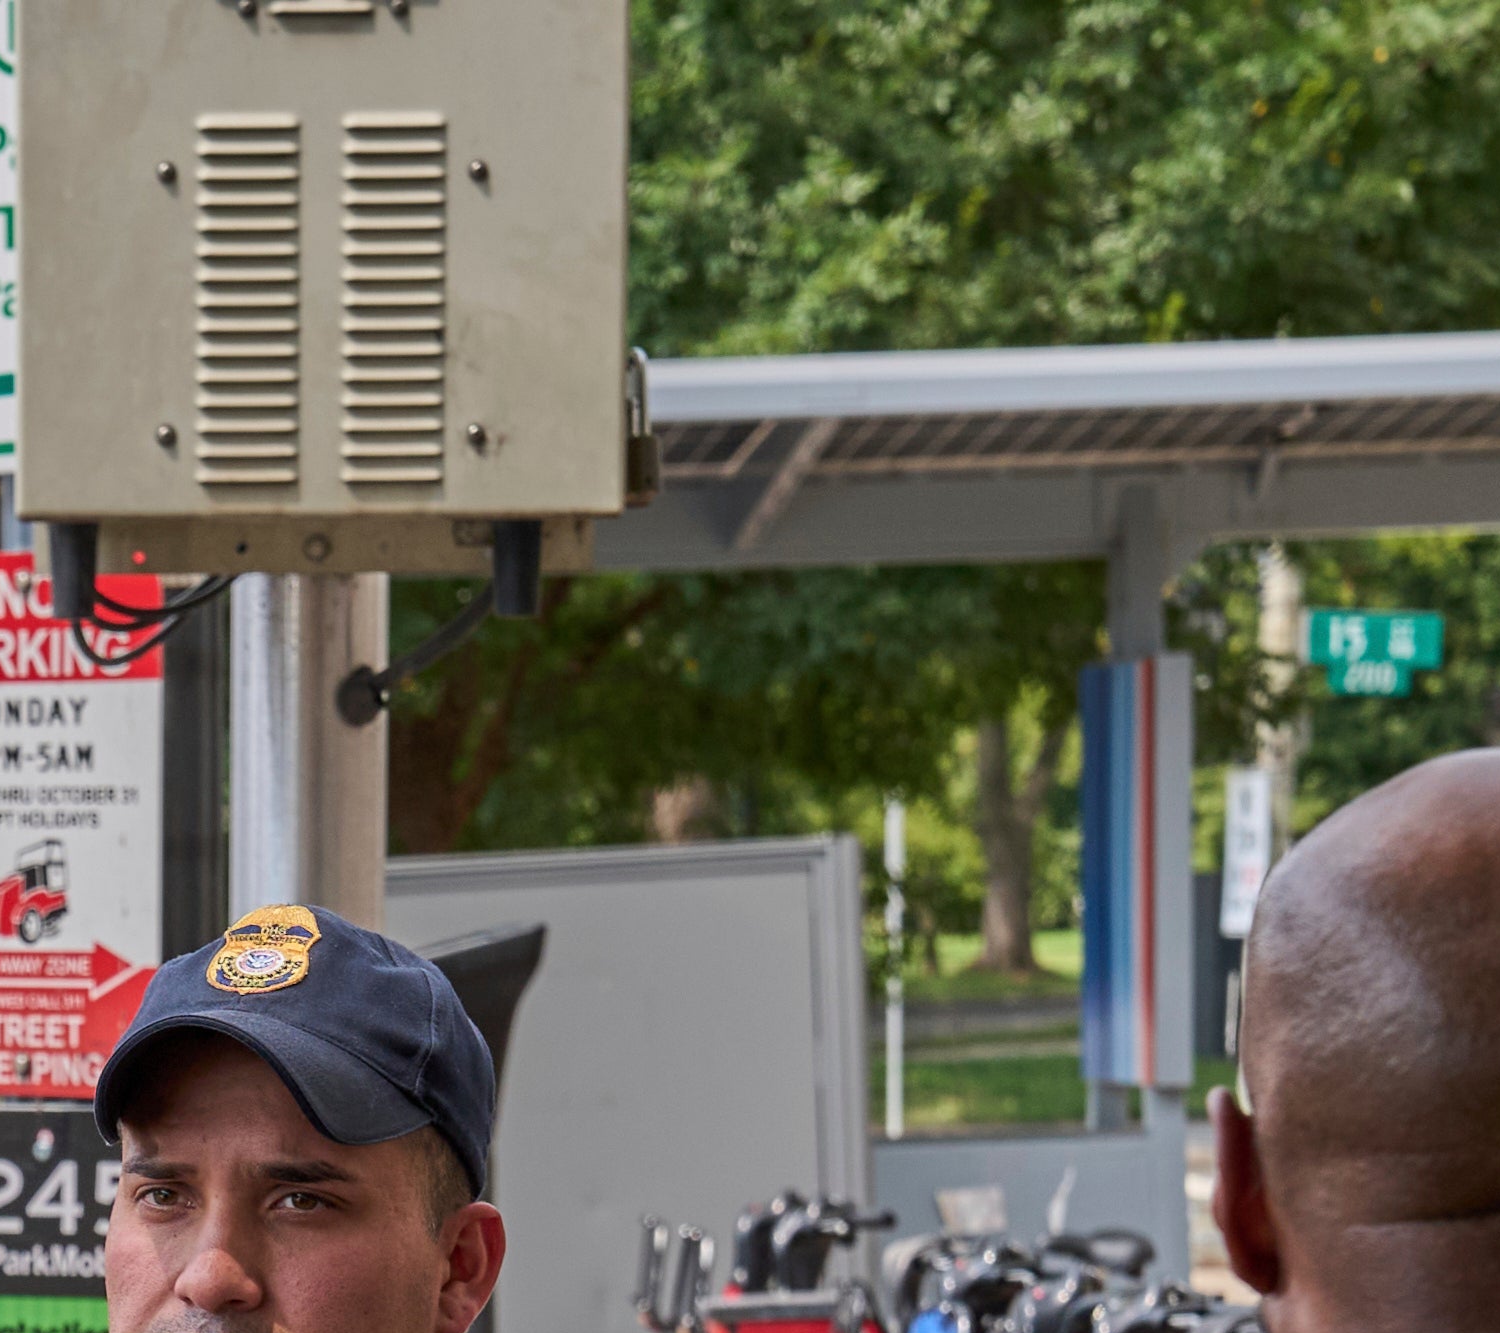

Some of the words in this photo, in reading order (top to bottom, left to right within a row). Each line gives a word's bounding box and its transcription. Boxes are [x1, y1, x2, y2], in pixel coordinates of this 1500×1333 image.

[37, 788, 116, 806] OCTOBER
[19, 812, 101, 830] HOLIDAYS
[0, 956, 41, 976] AWAY
[45, 956, 93, 976] ZONE
